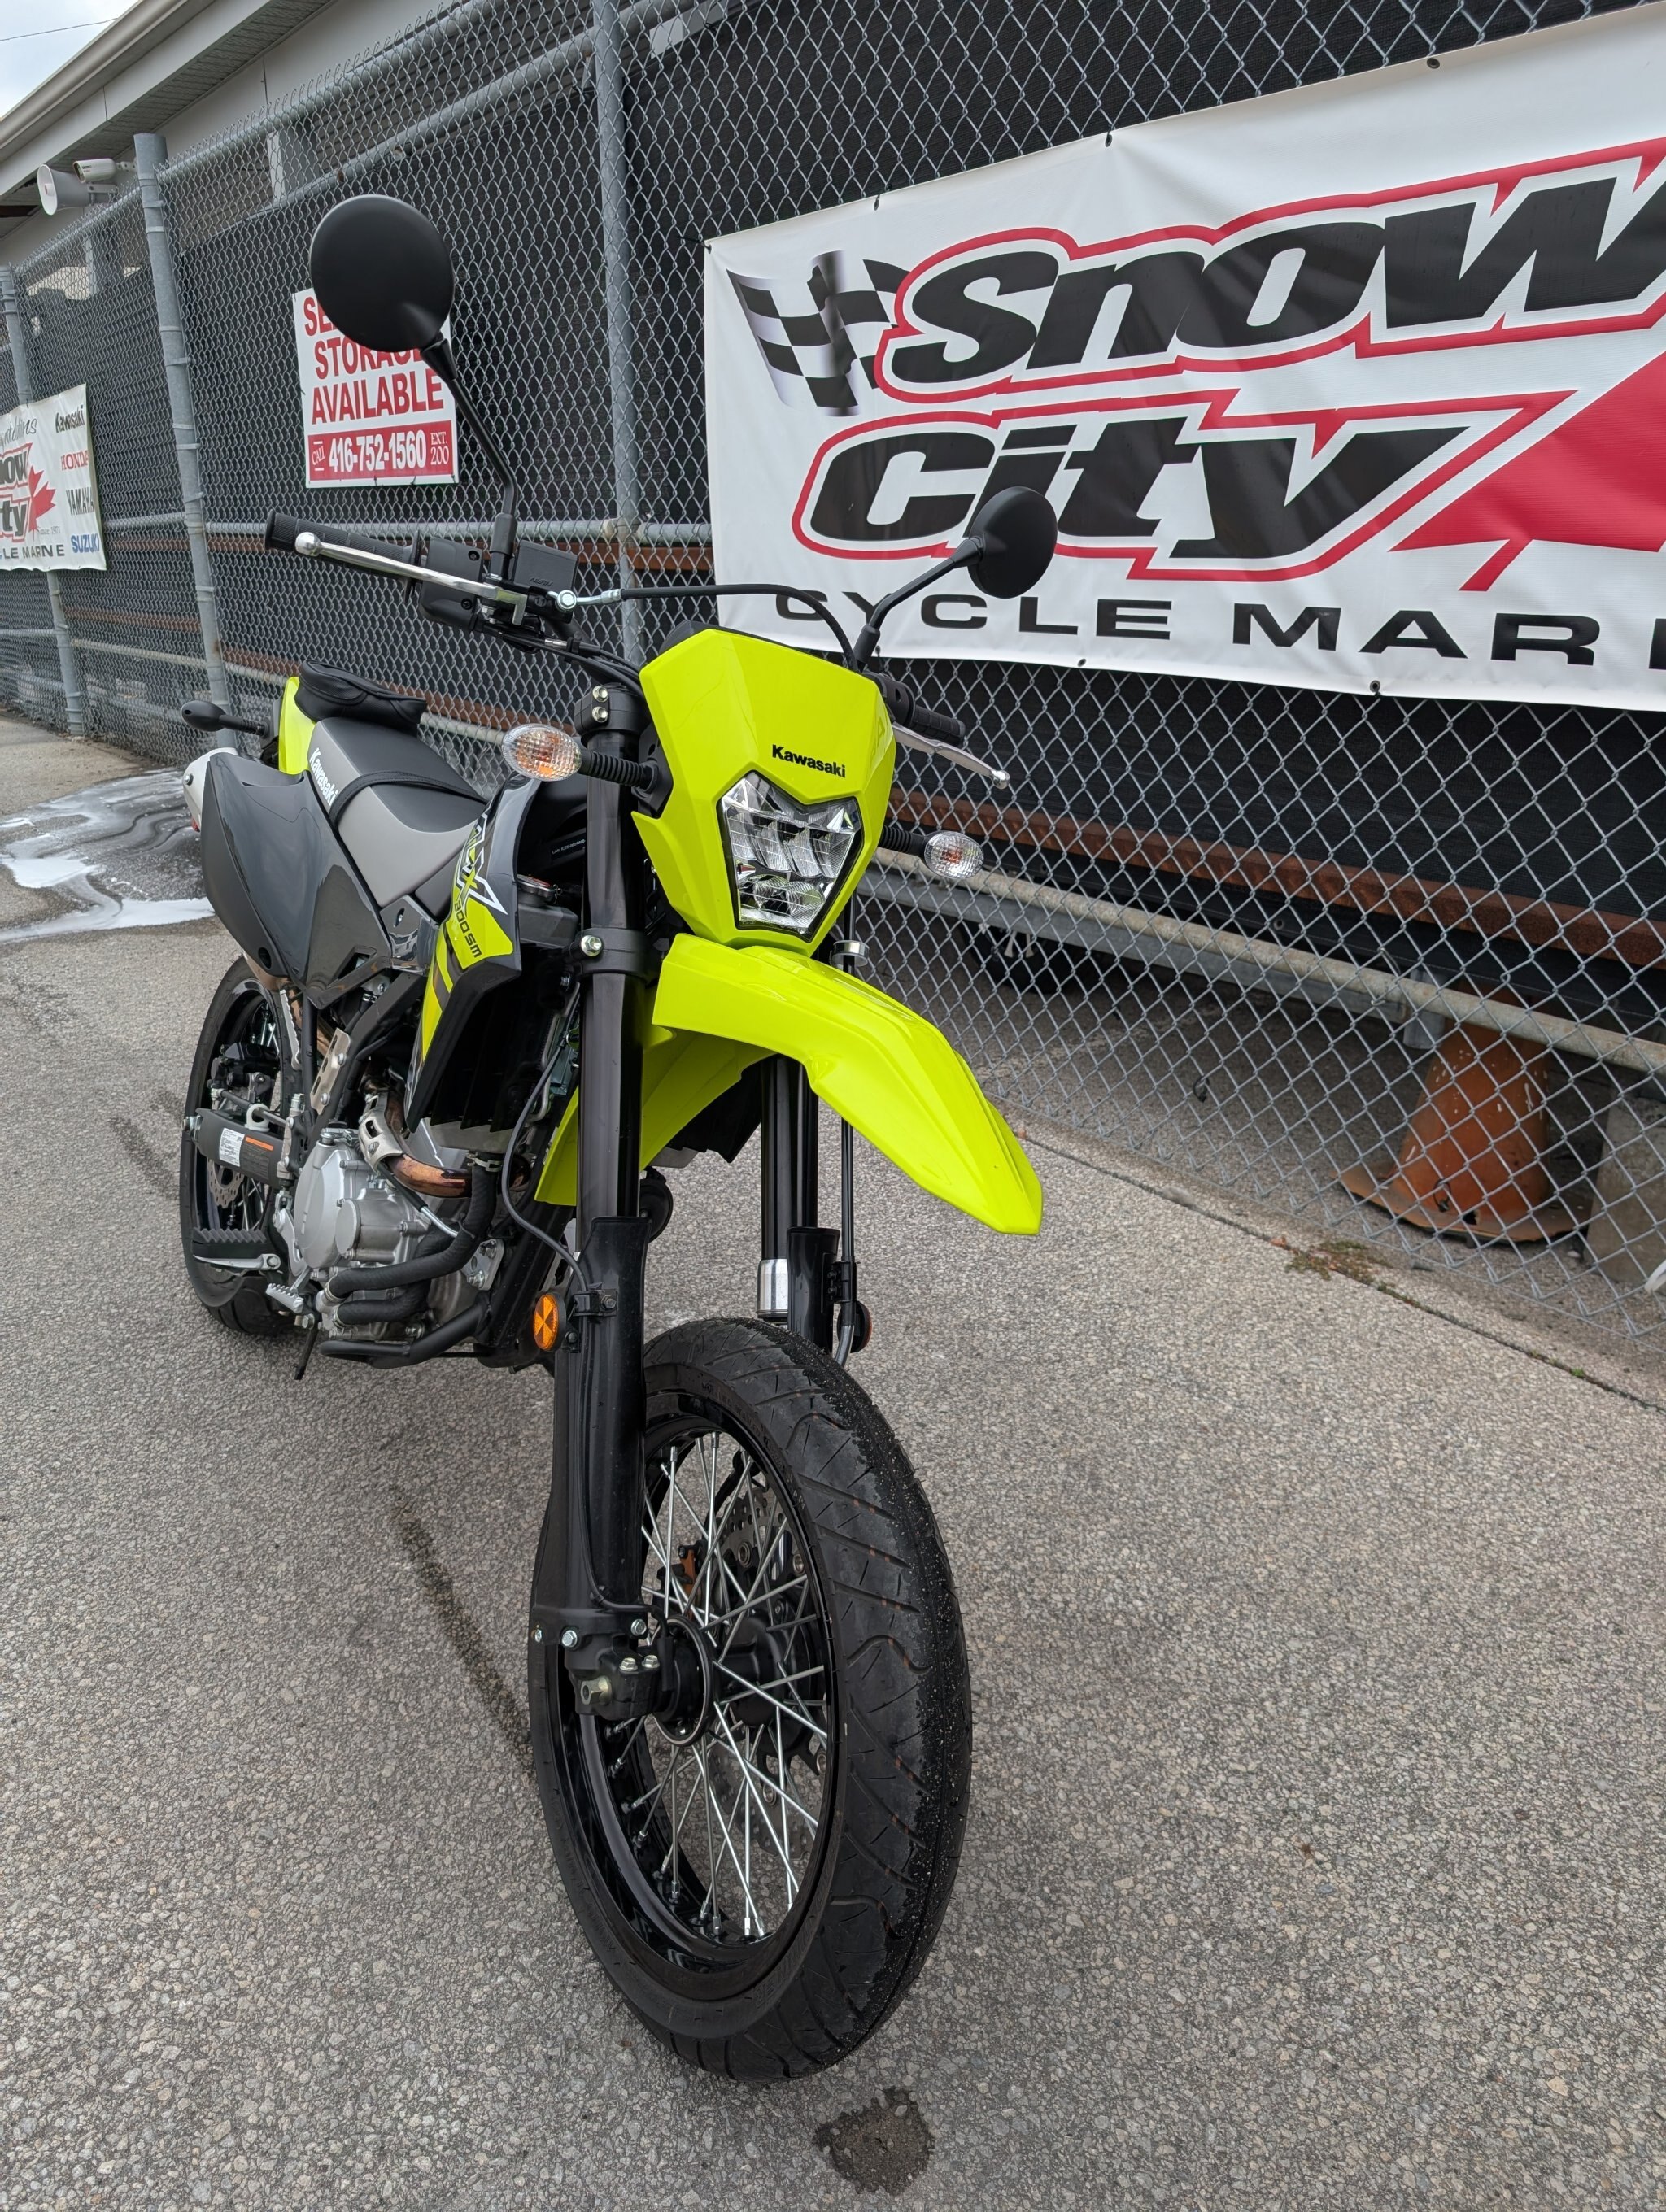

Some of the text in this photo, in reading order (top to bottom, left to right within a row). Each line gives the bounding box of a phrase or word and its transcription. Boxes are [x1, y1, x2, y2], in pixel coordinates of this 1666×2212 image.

[891, 176, 1666, 384] Snow
[314, 335, 424, 380] STOR
[312, 368, 444, 425] AVAILABLE
[312, 429, 427, 472] CALL 416-752-1560
[430, 432, 447, 445] EXT.
[430, 446, 449, 465] 200
[809, 417, 1471, 560] City
[22, 544, 65, 559] MARNE
[309, 747, 339, 807] Kawasaki
[772, 744, 846, 778] Kawasaki
[454, 899, 470, 932] 300
